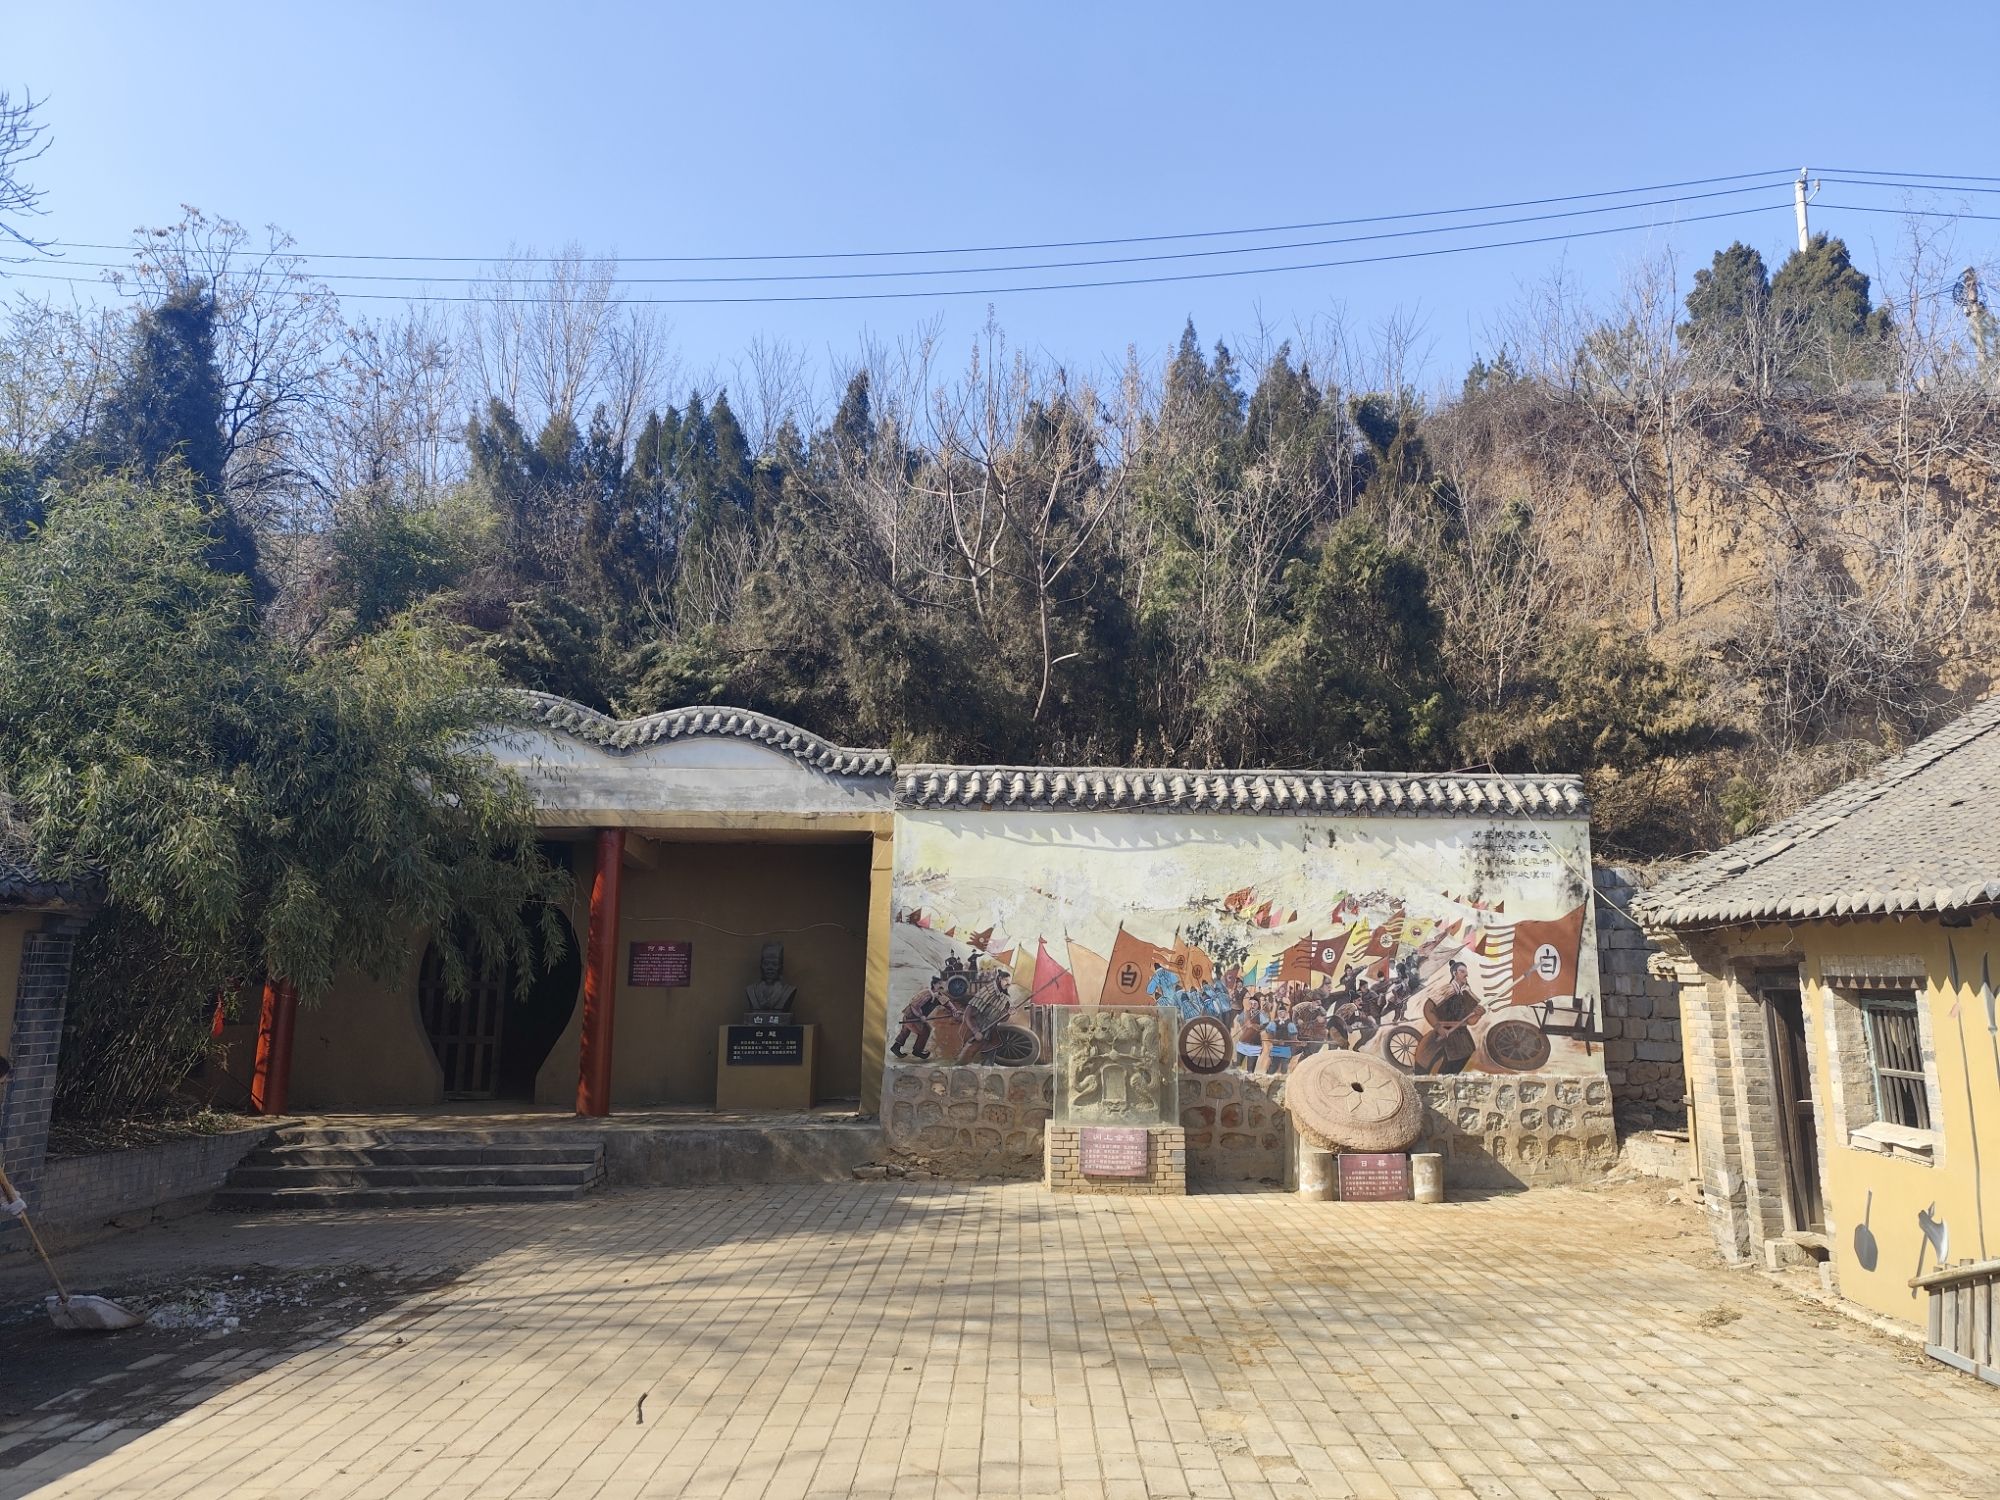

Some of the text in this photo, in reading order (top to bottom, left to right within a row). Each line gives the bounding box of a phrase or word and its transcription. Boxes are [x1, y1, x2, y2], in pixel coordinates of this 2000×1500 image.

[1325, 949, 1333, 960] 白
[1540, 949, 1556, 974] 白
[1122, 965, 1137, 987] 白
